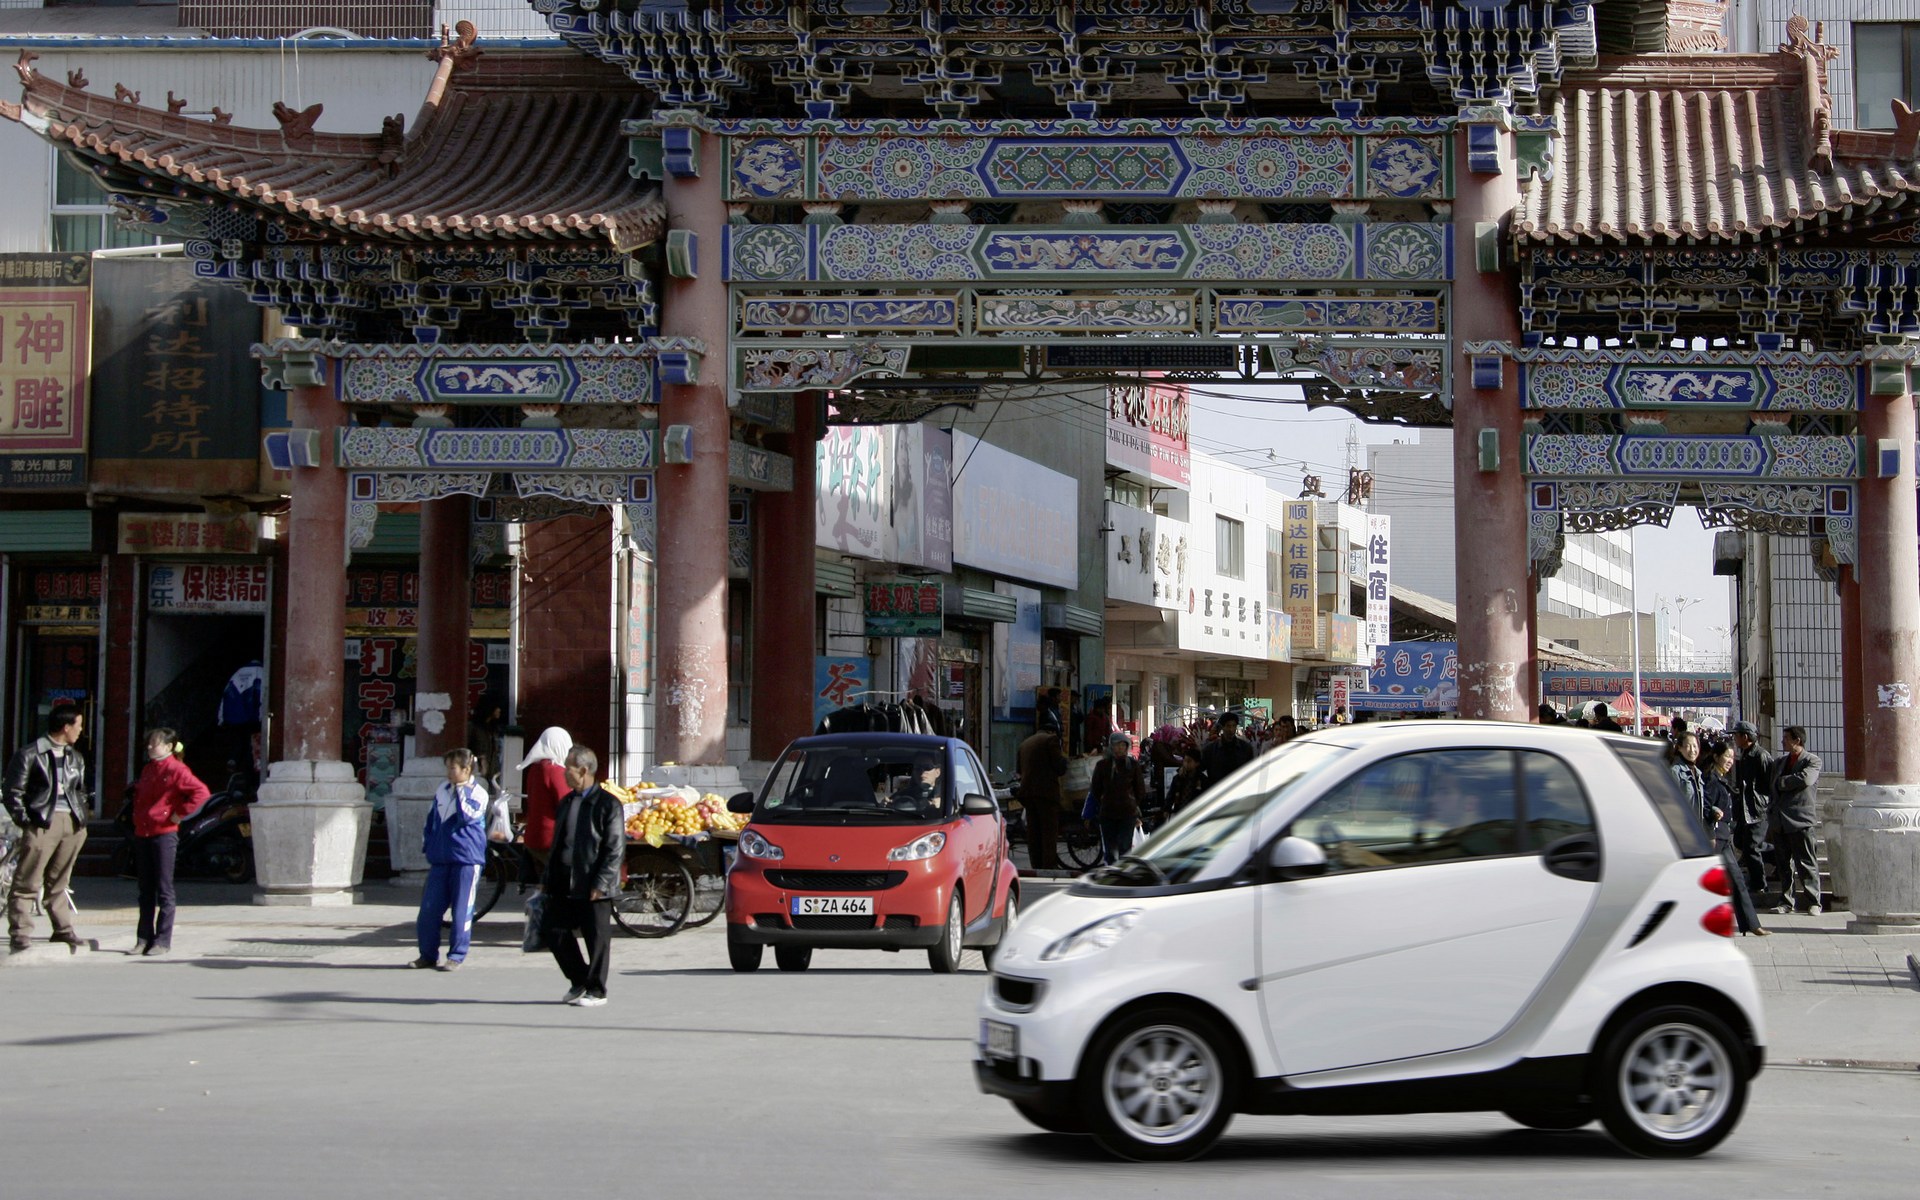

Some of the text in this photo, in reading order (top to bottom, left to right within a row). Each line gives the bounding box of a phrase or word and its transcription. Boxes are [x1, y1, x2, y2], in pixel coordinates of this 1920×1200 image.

[12, 312, 64, 429] 神雕
[11, 458, 73, 472] 激光雕刻
[1288, 504, 1310, 600] 顺达住宿所
[1368, 534, 1389, 601] 住宿
[182, 565, 266, 602] 保健精品
[869, 584, 940, 613] 铁观音
[820, 663, 863, 707] 茶
[804, 899, 867, 913] S ZA 464
